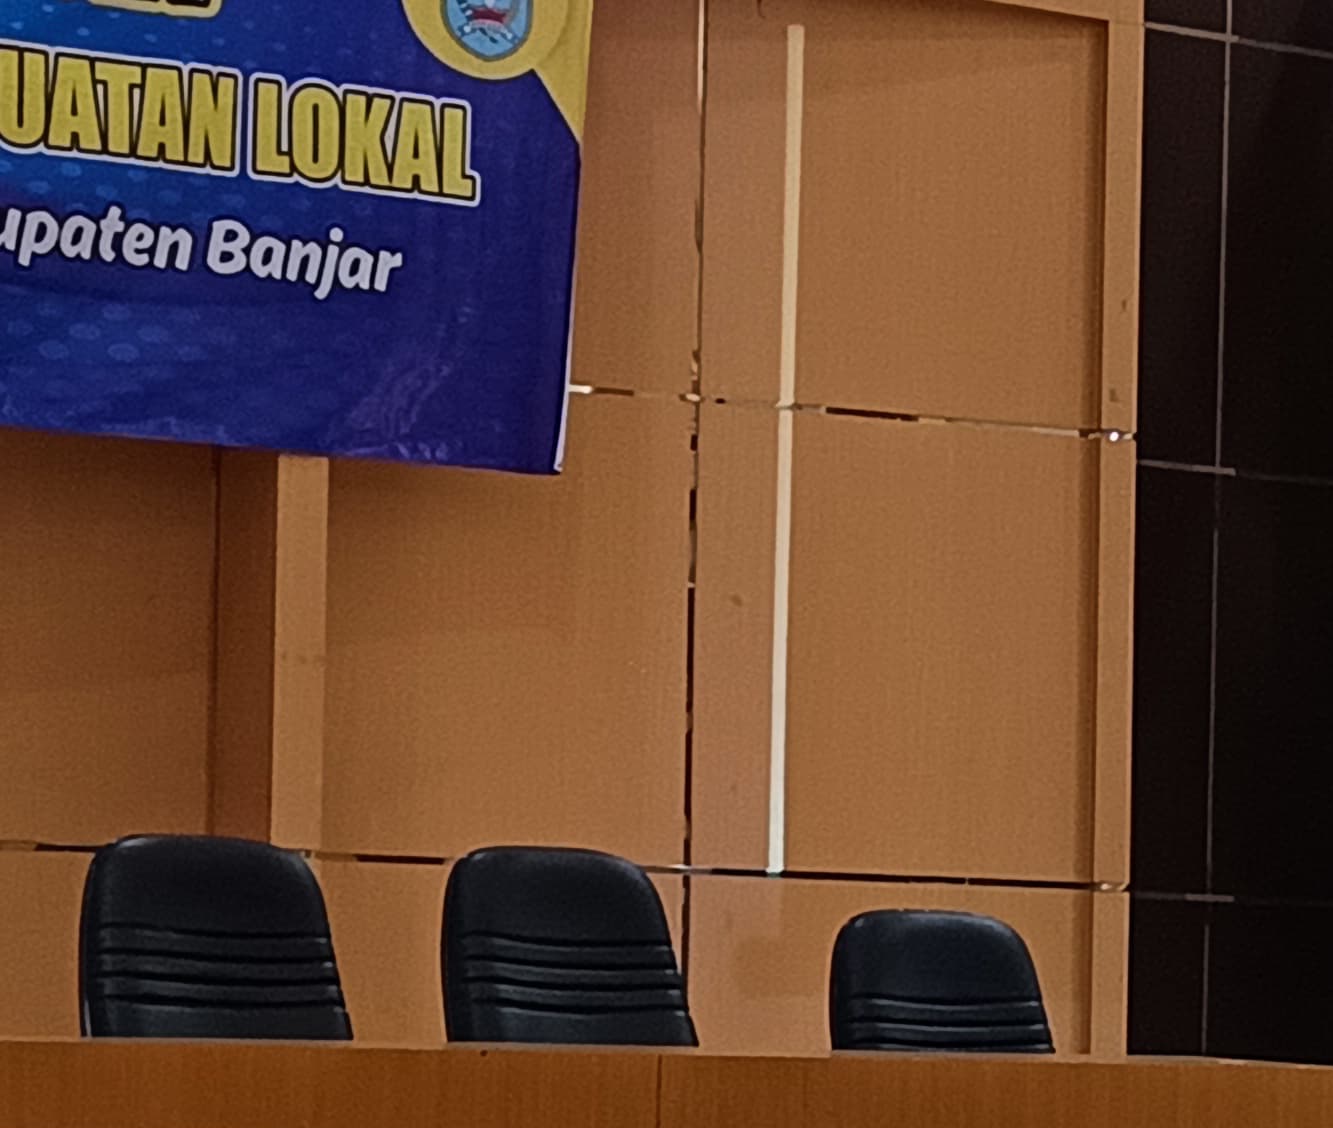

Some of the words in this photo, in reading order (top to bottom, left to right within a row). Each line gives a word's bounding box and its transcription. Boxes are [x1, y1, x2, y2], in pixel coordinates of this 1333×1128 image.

[0, 45, 239, 172] UATAN
[253, 77, 478, 201] LOKAL
[207, 218, 403, 300] Banjar
